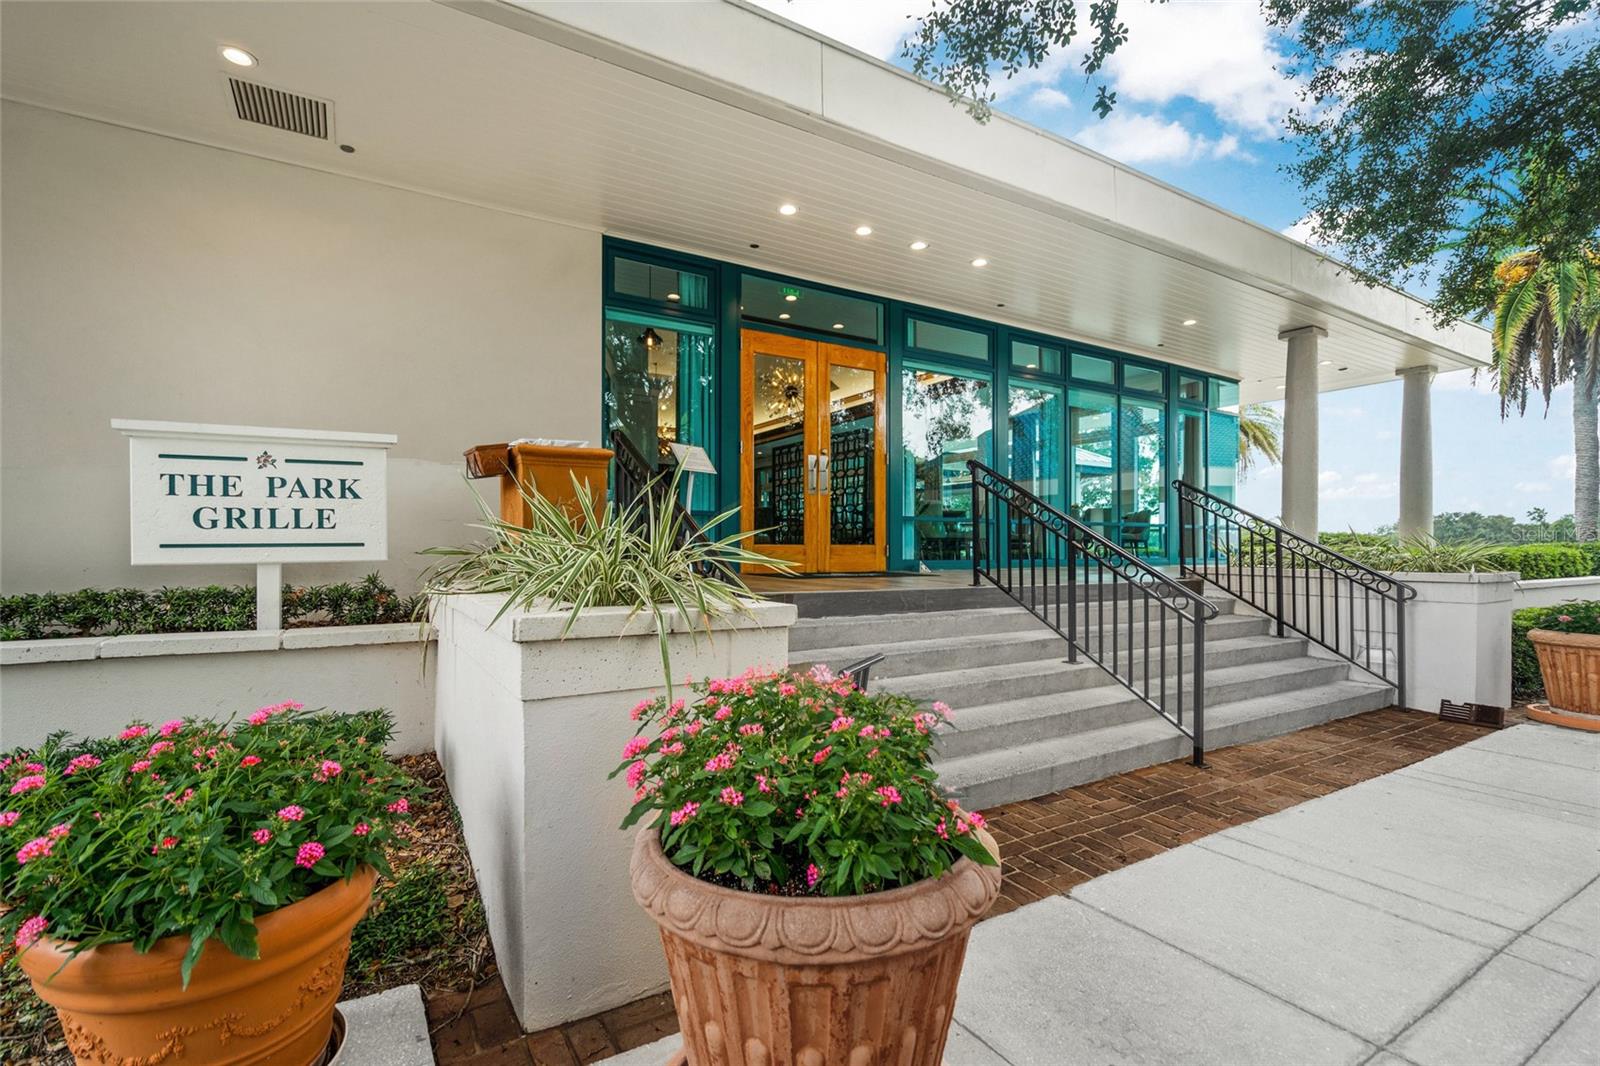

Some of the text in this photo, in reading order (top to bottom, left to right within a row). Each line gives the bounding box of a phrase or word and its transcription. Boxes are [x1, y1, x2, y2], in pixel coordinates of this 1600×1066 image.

[159, 473, 363, 500] THE PARK
[192, 506, 337, 530] GRILLE
